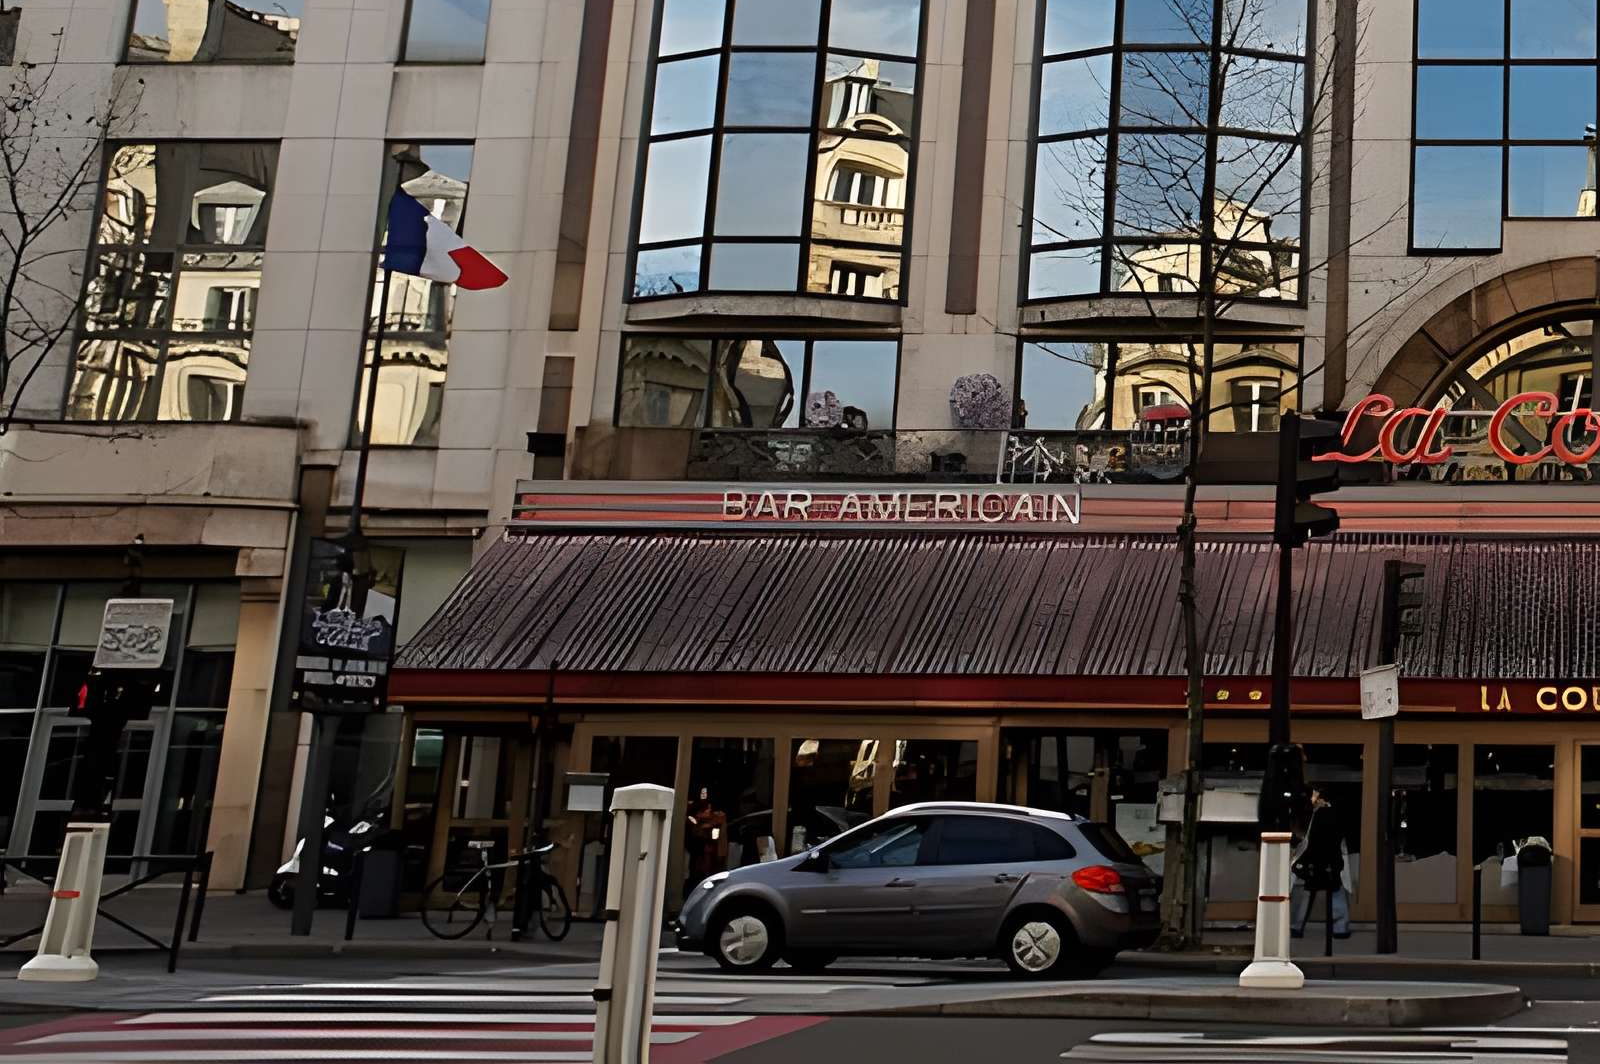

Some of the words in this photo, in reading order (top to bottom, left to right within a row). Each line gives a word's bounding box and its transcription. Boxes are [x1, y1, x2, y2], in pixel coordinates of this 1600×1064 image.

[1312, 393, 1453, 464] La
[723, 491, 811, 521] BAR
[838, 491, 1081, 524] AMERICAIN
[1480, 686, 1512, 711] LA
